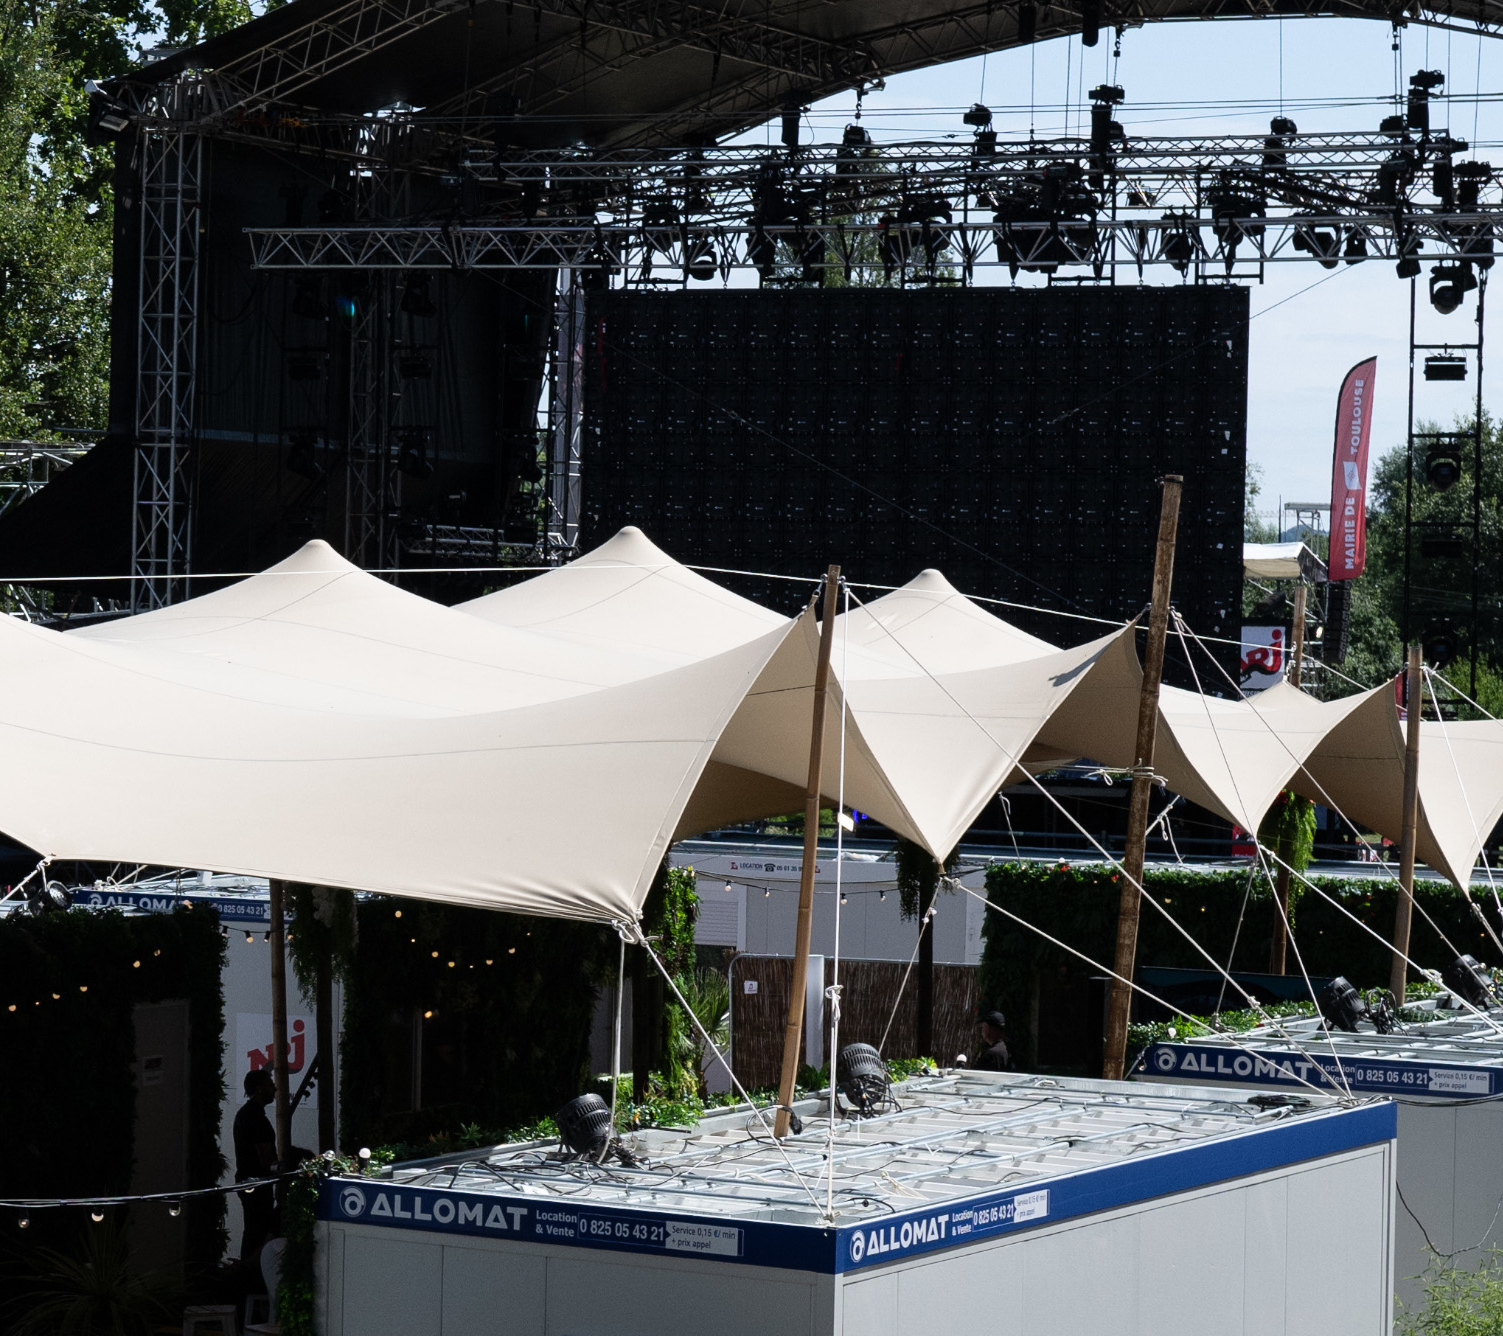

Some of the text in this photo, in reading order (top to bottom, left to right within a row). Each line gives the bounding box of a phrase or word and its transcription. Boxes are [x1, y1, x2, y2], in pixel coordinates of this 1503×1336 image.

[1344, 379, 1364, 569] MAIRIE DE TOULOUSE
[1180, 1052, 1313, 1081] ALLOMAT
[1357, 1069, 1364, 1081] 0
[1365, 1069, 1385, 1083] 825
[1386, 1070, 1400, 1083] 05
[1401, 1072, 1414, 1084] 43
[1416, 1073, 1429, 1085] 21
[369, 1192, 528, 1231] ALLOMAT
[535, 1209, 578, 1224] Location
[579, 1218, 587, 1233] 0
[590, 1219, 612, 1236] 825
[614, 1221, 630, 1238] 05
[632, 1223, 648, 1240] 43
[650, 1225, 664, 1242] 21
[671, 1225, 696, 1236] Service
[697, 1228, 713, 1239] 0,15
[722, 1230, 736, 1240] min
[535, 1223, 544, 1234] &
[546, 1224, 575, 1237] Vente
[677, 1238, 691, 1249] prix
[692, 1239, 712, 1250] appel
[866, 1214, 949, 1257] ALLOMAT
[973, 1211, 978, 1226] 0
[978, 1209, 990, 1224] 825
[990, 1206, 998, 1222] 05
[998, 1205, 1007, 1220] 43
[1007, 1203, 1014, 1218] 21
